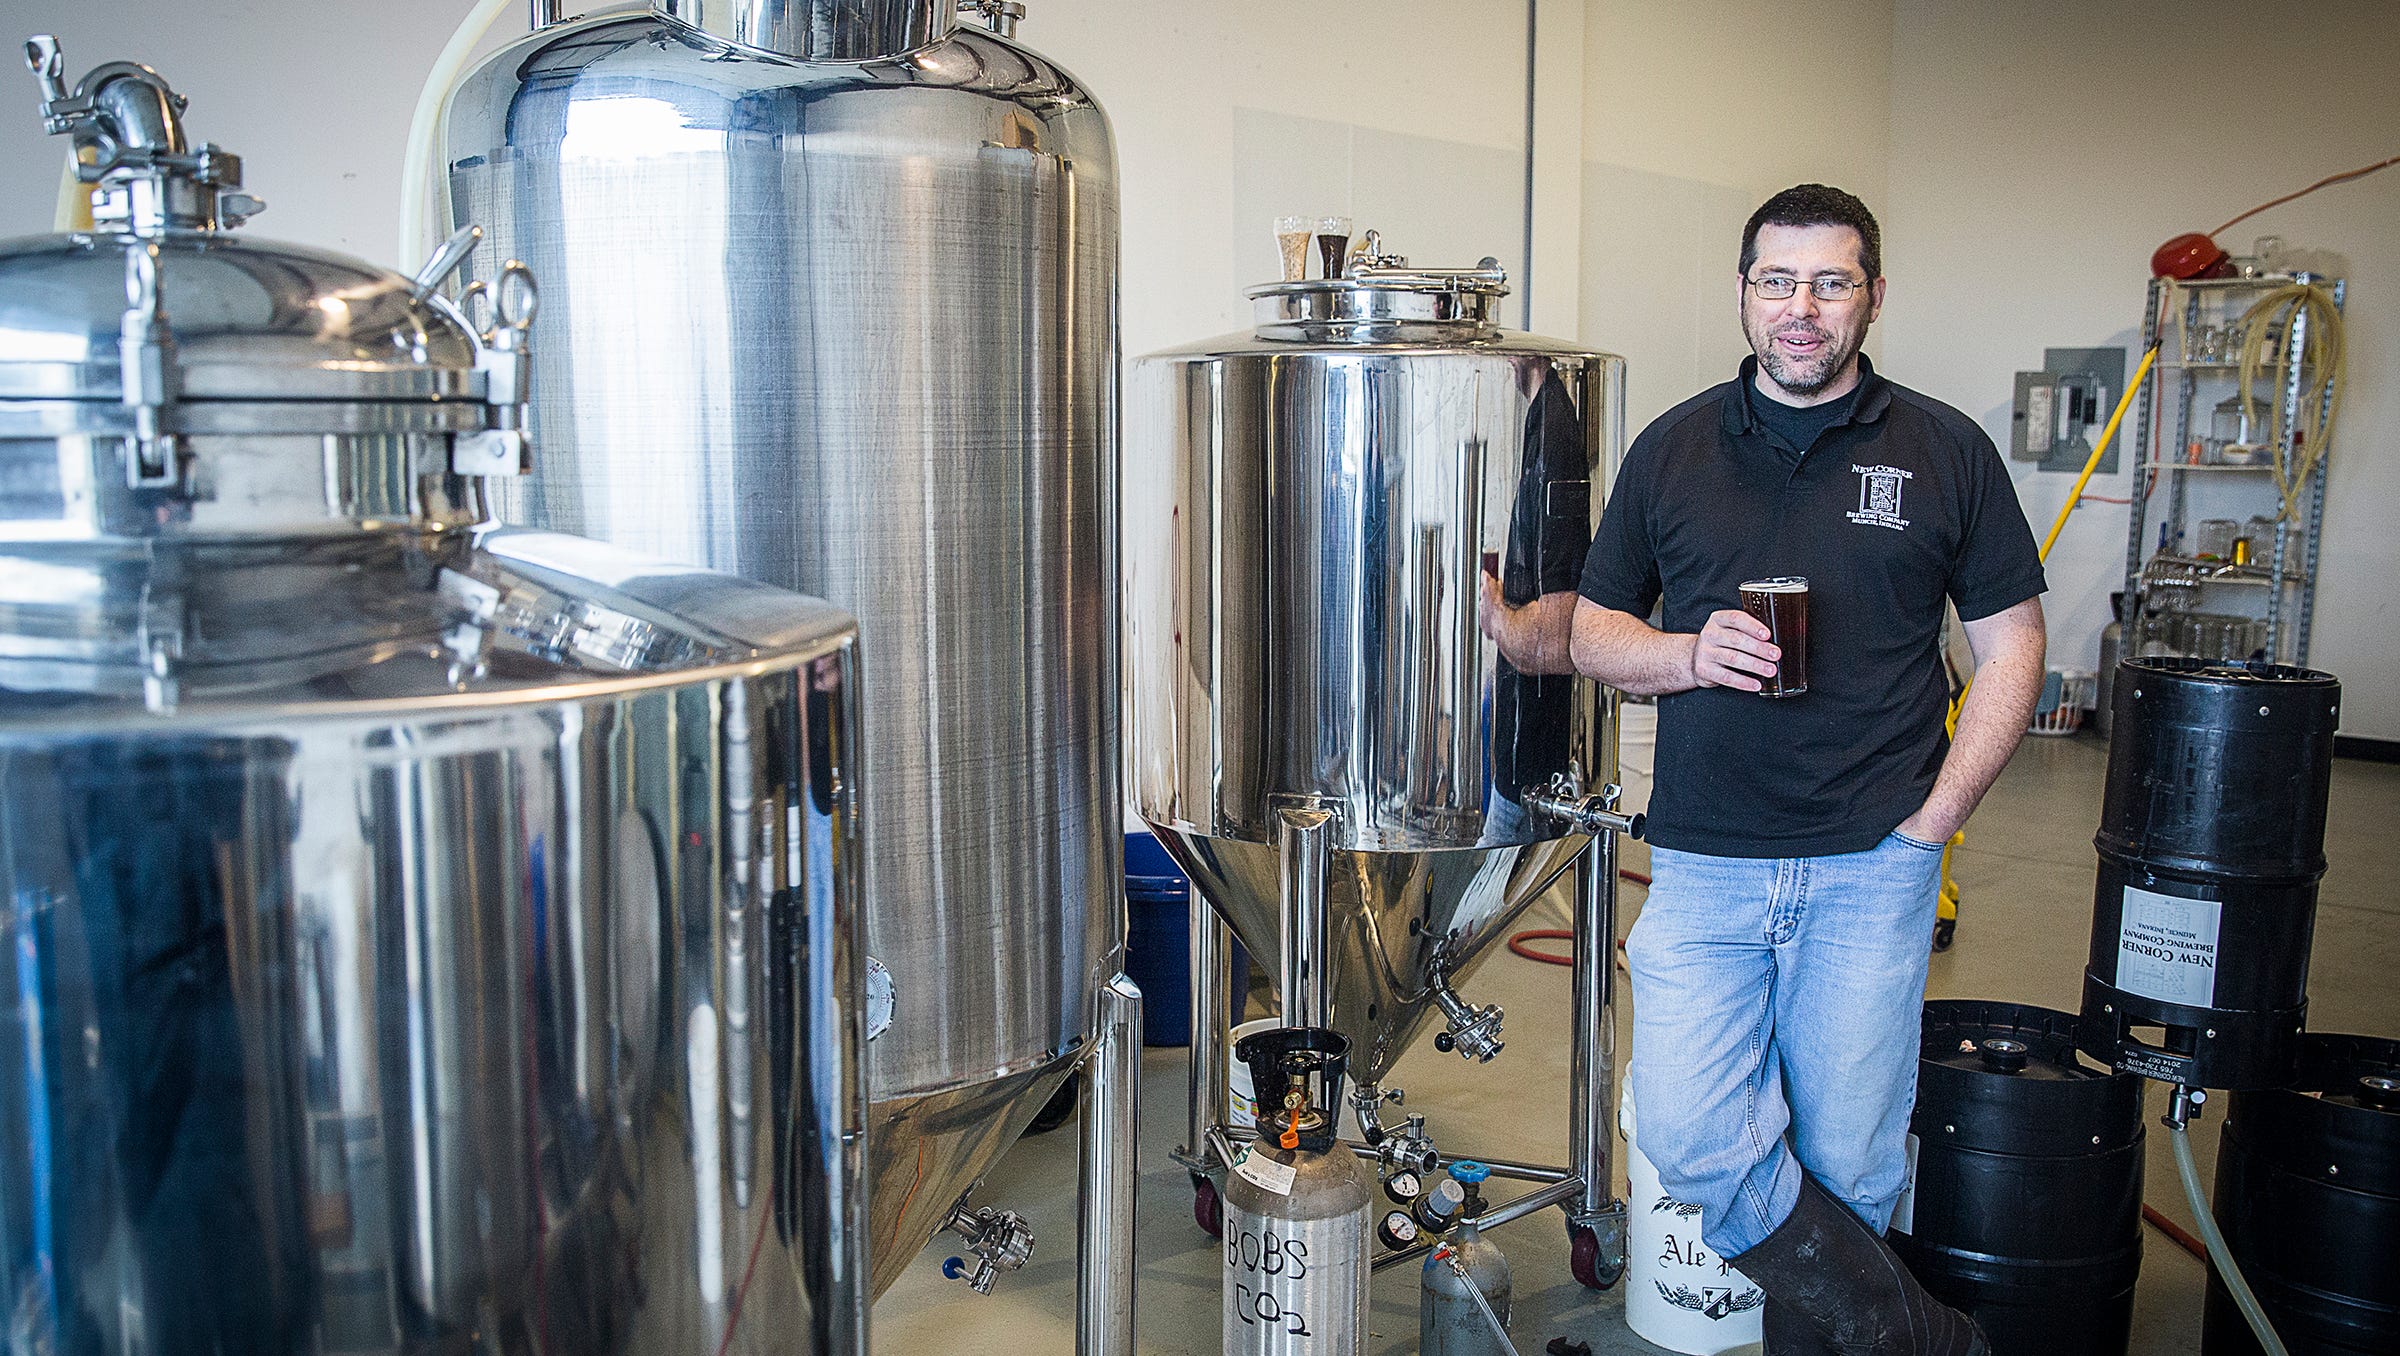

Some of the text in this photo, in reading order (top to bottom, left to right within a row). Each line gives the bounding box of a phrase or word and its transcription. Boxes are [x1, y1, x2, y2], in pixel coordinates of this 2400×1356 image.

[1851, 464, 1913, 479] NEW CORNER
[1846, 511, 1910, 526] BREWING COMPANY
[2137, 922, 2164, 934] INDIANA
[2122, 928, 2214, 953] BREWING COMPANY
[2122, 939, 2214, 968] NEW CORNER
[2163, 1059, 2181, 1068] 2014
[2148, 1069, 2172, 1080] CORNER
[1228, 1218, 1309, 1280] BOBS
[1658, 1233, 1706, 1269] Ale
